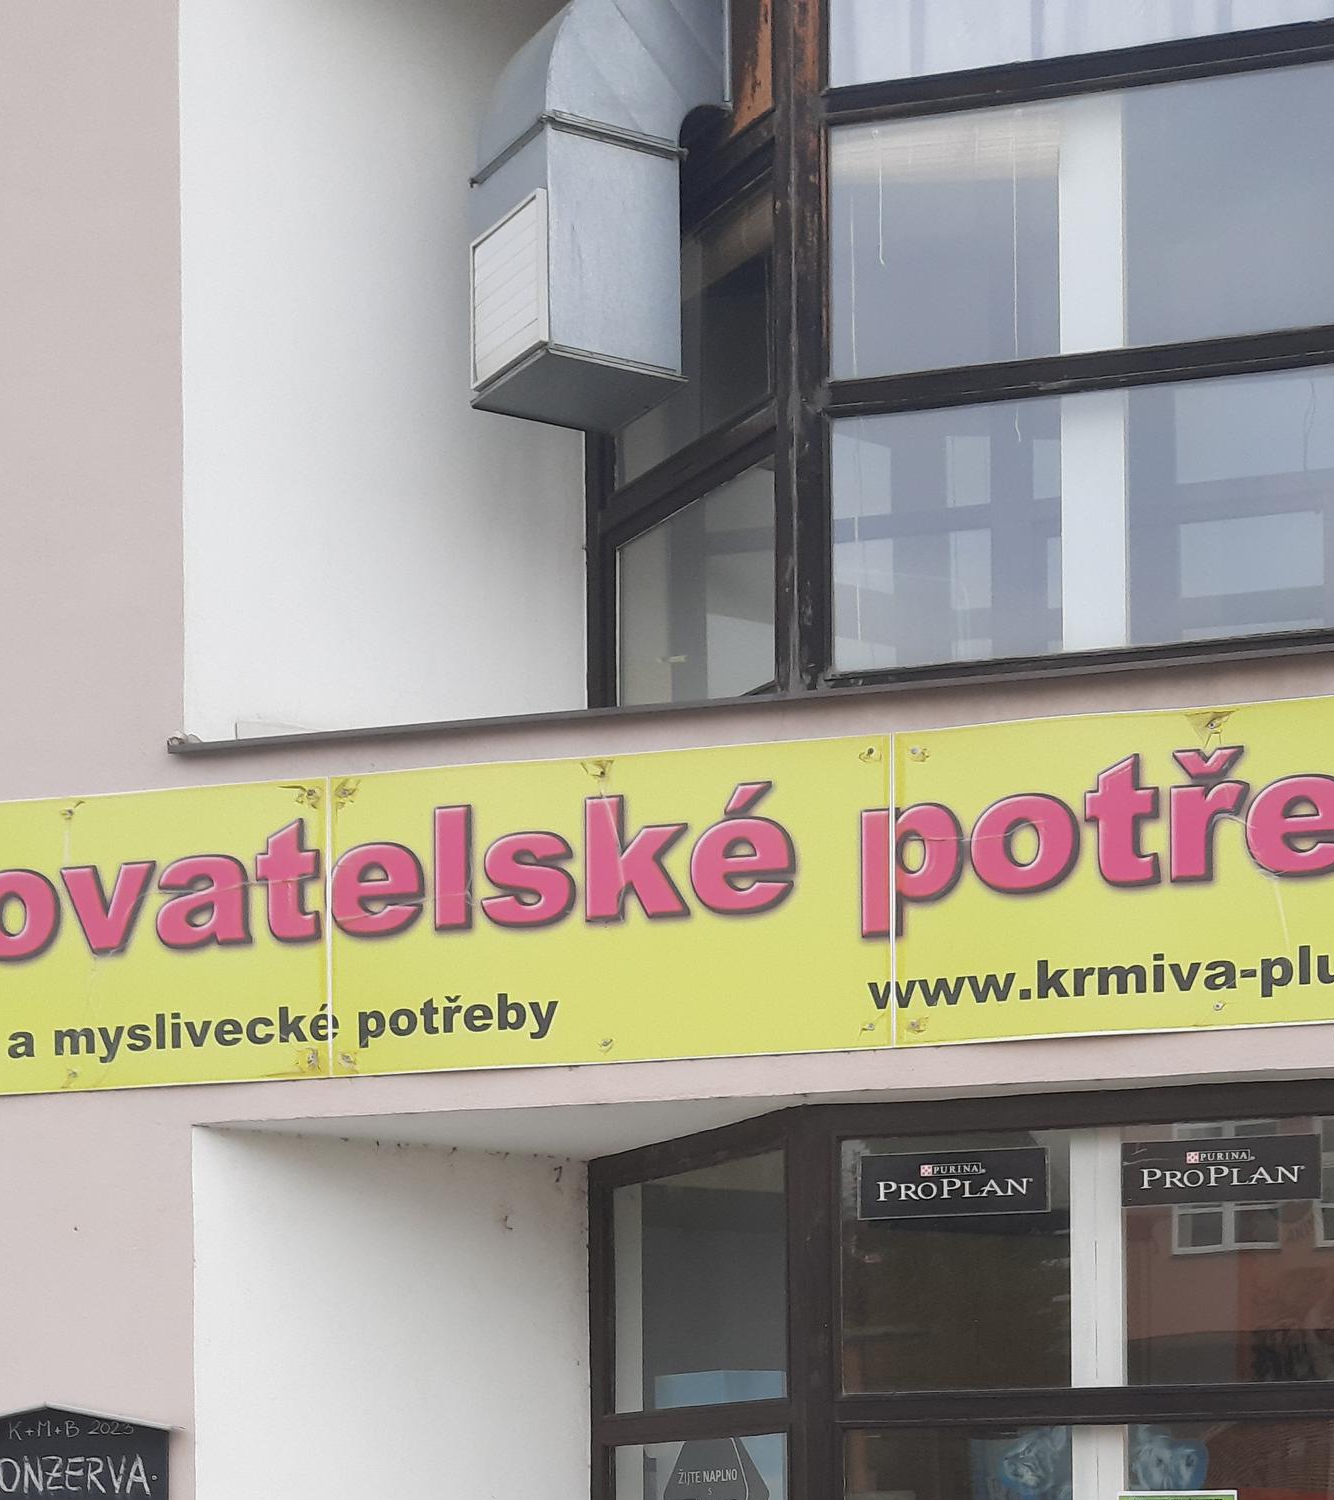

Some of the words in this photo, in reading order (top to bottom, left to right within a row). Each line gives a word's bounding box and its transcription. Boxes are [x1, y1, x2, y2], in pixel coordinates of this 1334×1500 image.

[7, 1029, 35, 1058] a
[54, 1003, 339, 1063] myslivecké
[358, 993, 559, 1047] potřeby
[1199, 1150, 1249, 1162] PURINA
[933, 1163, 981, 1175] PURINA
[677, 1468, 701, 1485] ŽIJTE
[703, 1468, 738, 1483] NAPLNO
